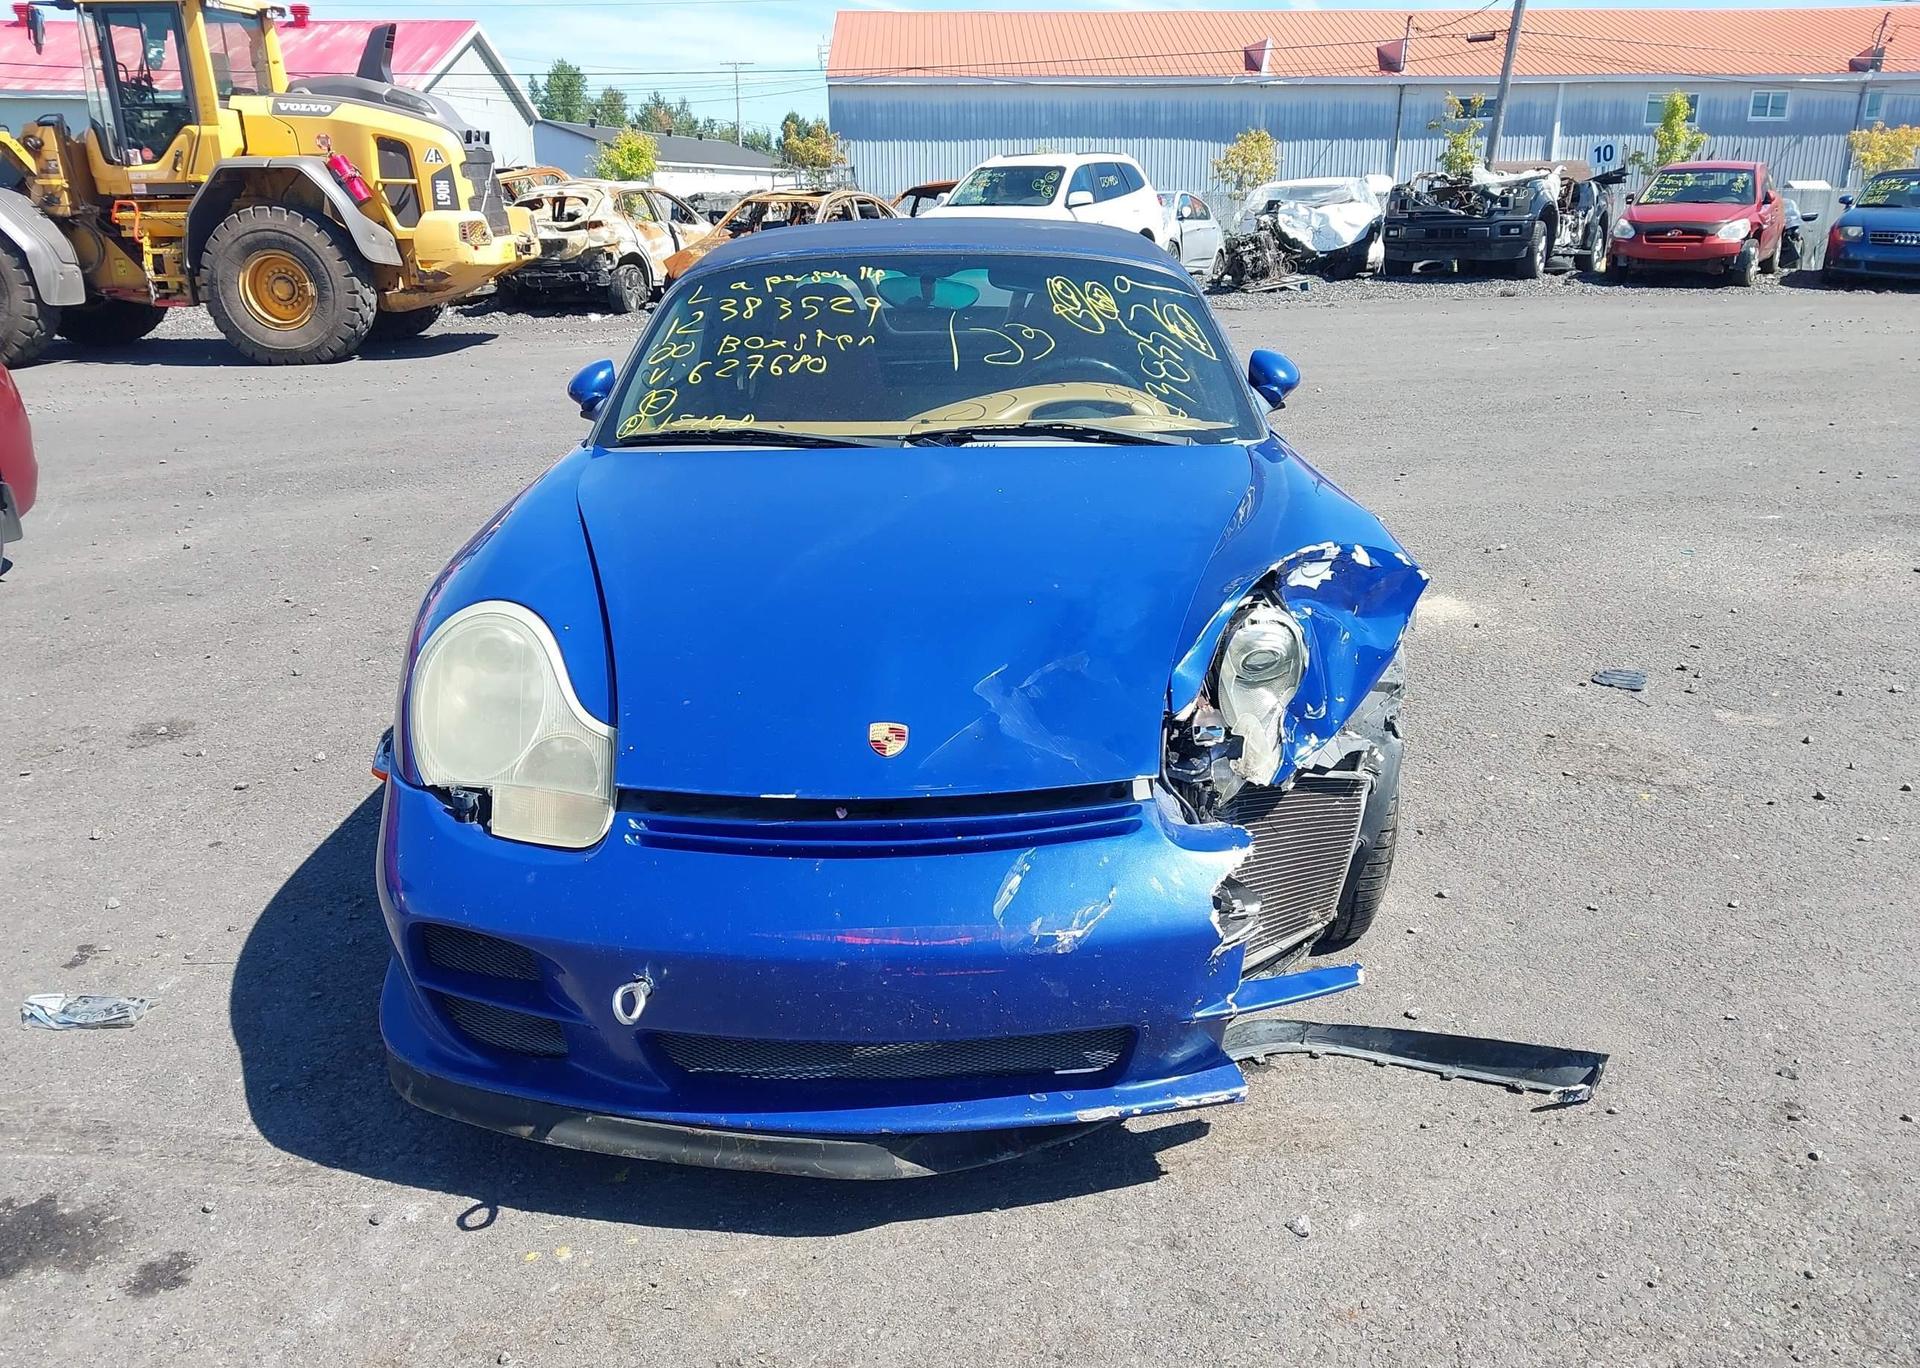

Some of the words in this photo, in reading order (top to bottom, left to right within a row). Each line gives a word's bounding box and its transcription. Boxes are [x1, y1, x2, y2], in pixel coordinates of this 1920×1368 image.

[278, 102, 332, 113] VOLVO
[1594, 144, 1614, 163] 10
[435, 180, 451, 206] L90H
[719, 297, 882, 328] 383529
